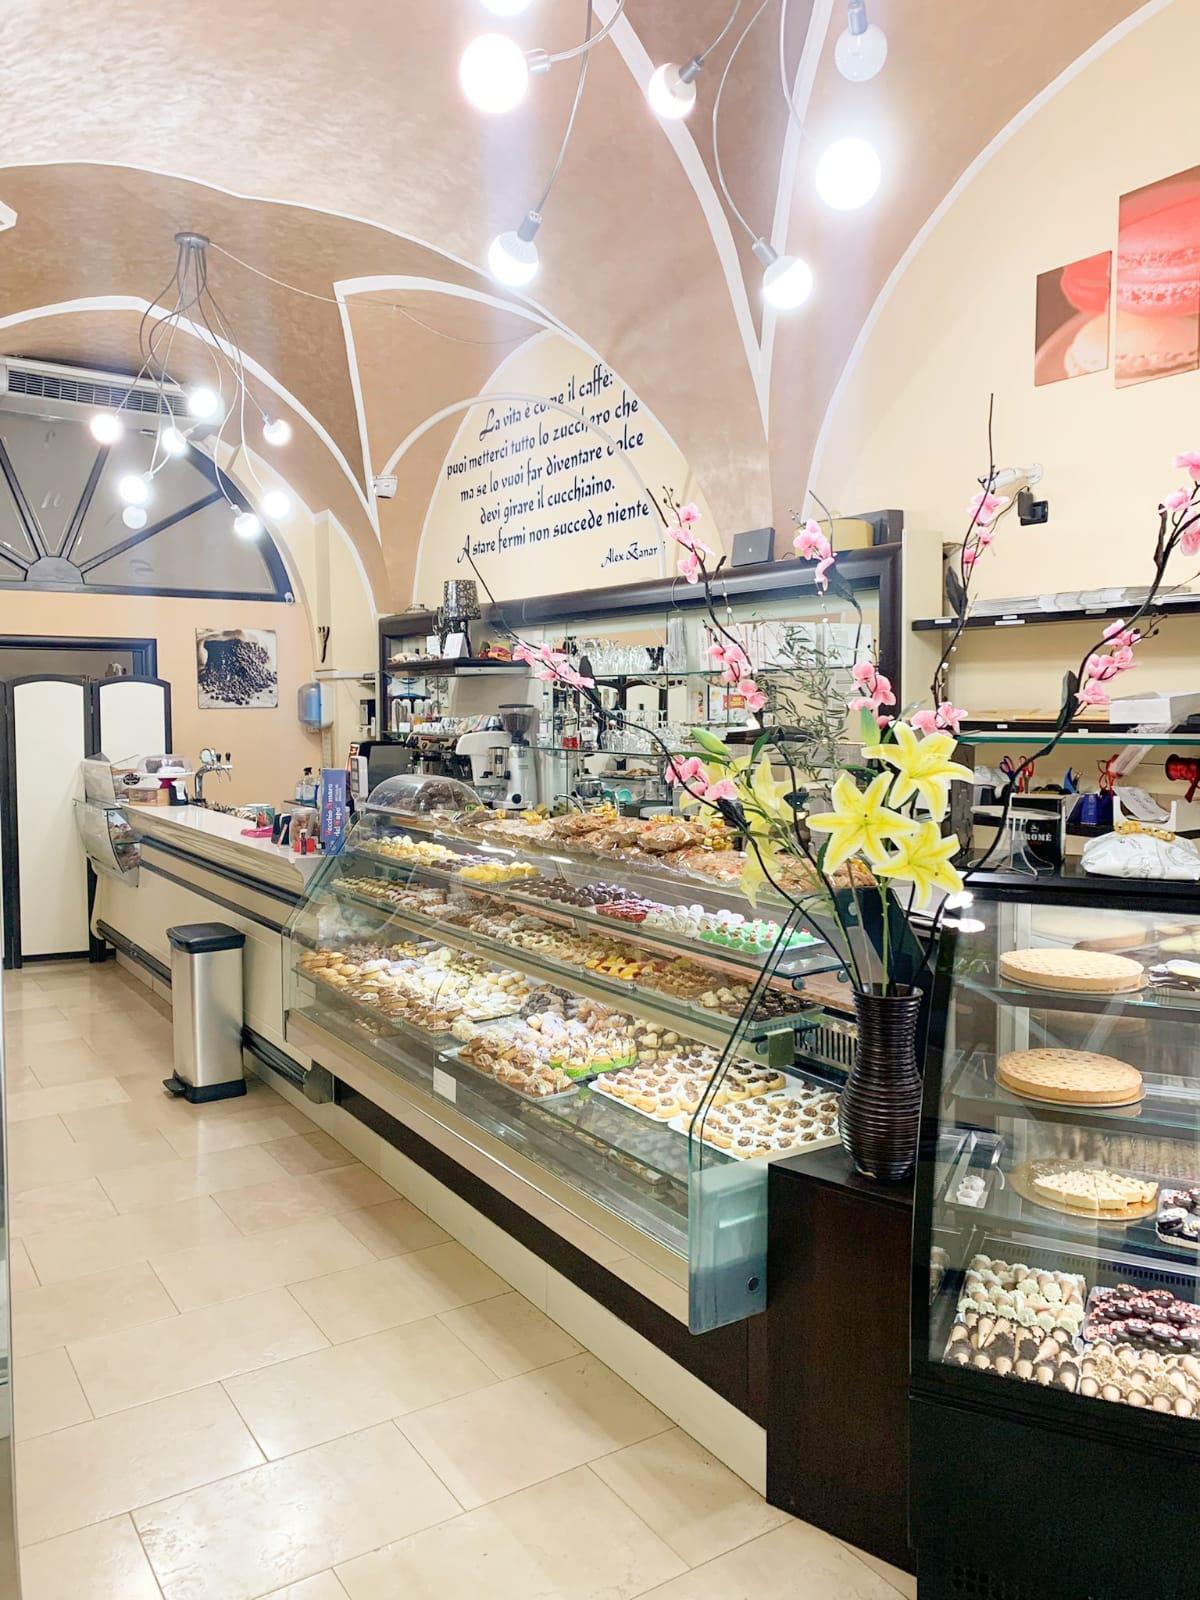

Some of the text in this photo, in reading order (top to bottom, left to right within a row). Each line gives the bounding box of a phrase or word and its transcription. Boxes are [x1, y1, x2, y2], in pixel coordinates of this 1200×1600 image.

[479, 408, 500, 441] La
[503, 406, 522, 428] vita
[524, 401, 531, 420] è
[568, 375, 575, 402] il
[579, 364, 613, 396] caffè:
[447, 456, 467, 480] puoi
[469, 440, 508, 469] metterci
[511, 436, 535, 455] tutto
[538, 422, 549, 446] lo
[615, 389, 638, 418] che
[460, 487, 474, 502] ma
[476, 484, 487, 497] se
[489, 470, 499, 493] lo
[501, 465, 523, 488] vuoi
[527, 457, 543, 487] far
[546, 446, 602, 476] diventare
[480, 475, 615, 525] devi girare il cucchiaino.
[456, 499, 650, 563] A stare fermi non succede niente
[601, 541, 666, 568] Alex Zanari
[1022, 833, 1052, 841] ROMÉ
